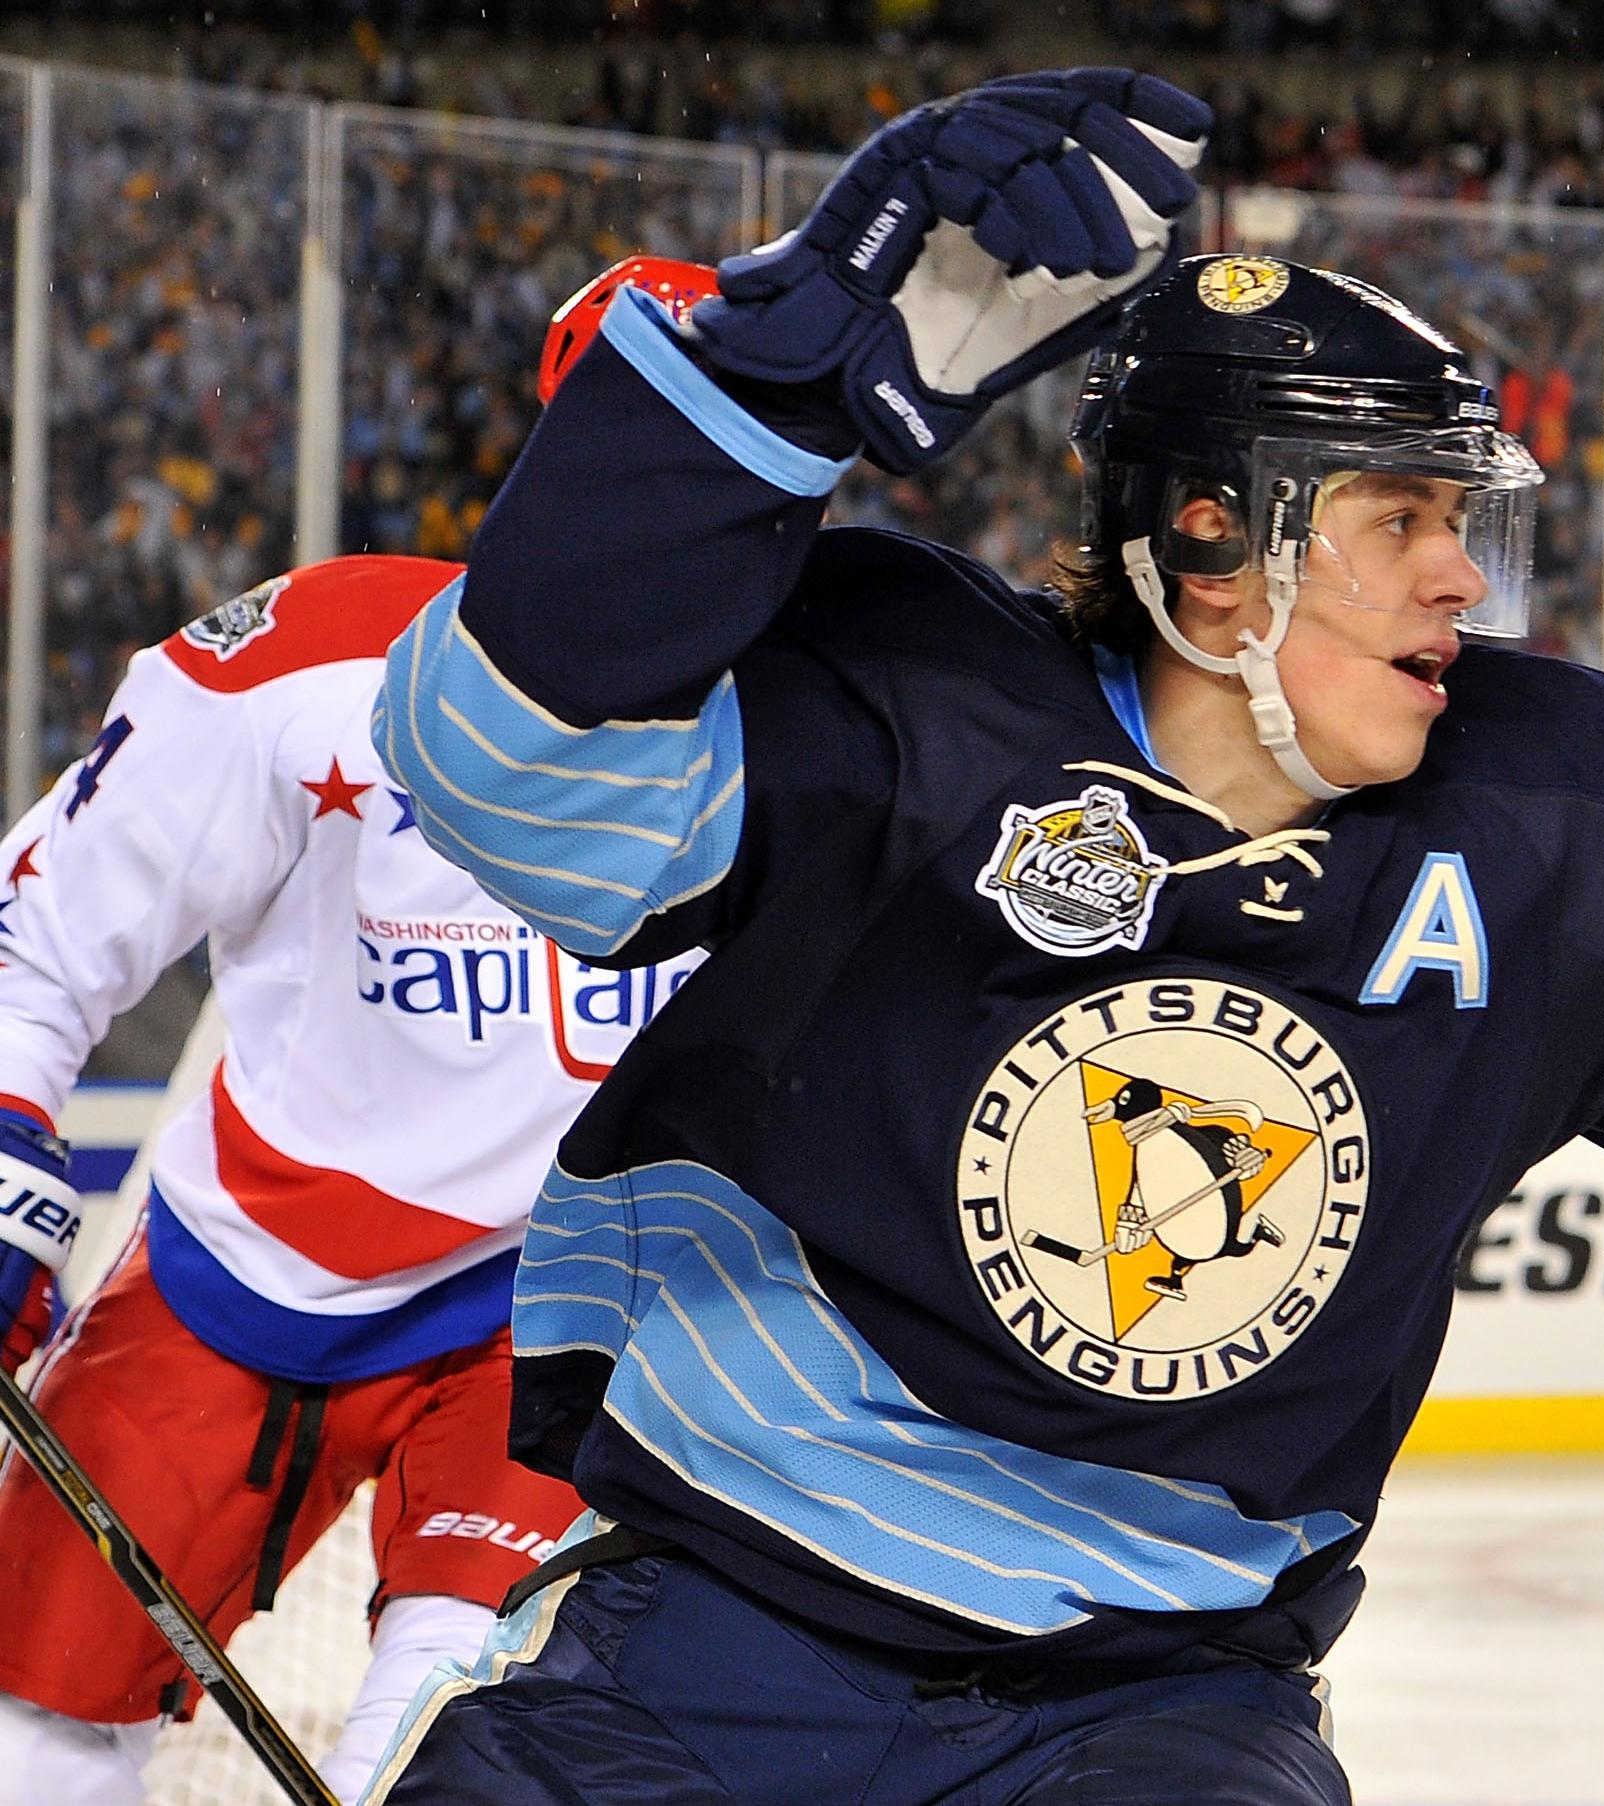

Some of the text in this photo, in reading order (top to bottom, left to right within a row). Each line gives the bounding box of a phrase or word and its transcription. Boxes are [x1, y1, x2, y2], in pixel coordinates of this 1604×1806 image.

[849, 197, 909, 272] MALKIN 71
[873, 380, 936, 449] BAUER
[1010, 824, 1142, 904] Winter
[1019, 867, 1122, 913] CLASSIC
[1358, 851, 1489, 1009] A
[972, 984, 1365, 1251] PITTSBURGH
[963, 1197, 1318, 1395] PENGUINS
[416, 1510, 557, 1563] BAUE
[147, 1600, 222, 1687] BAUER
